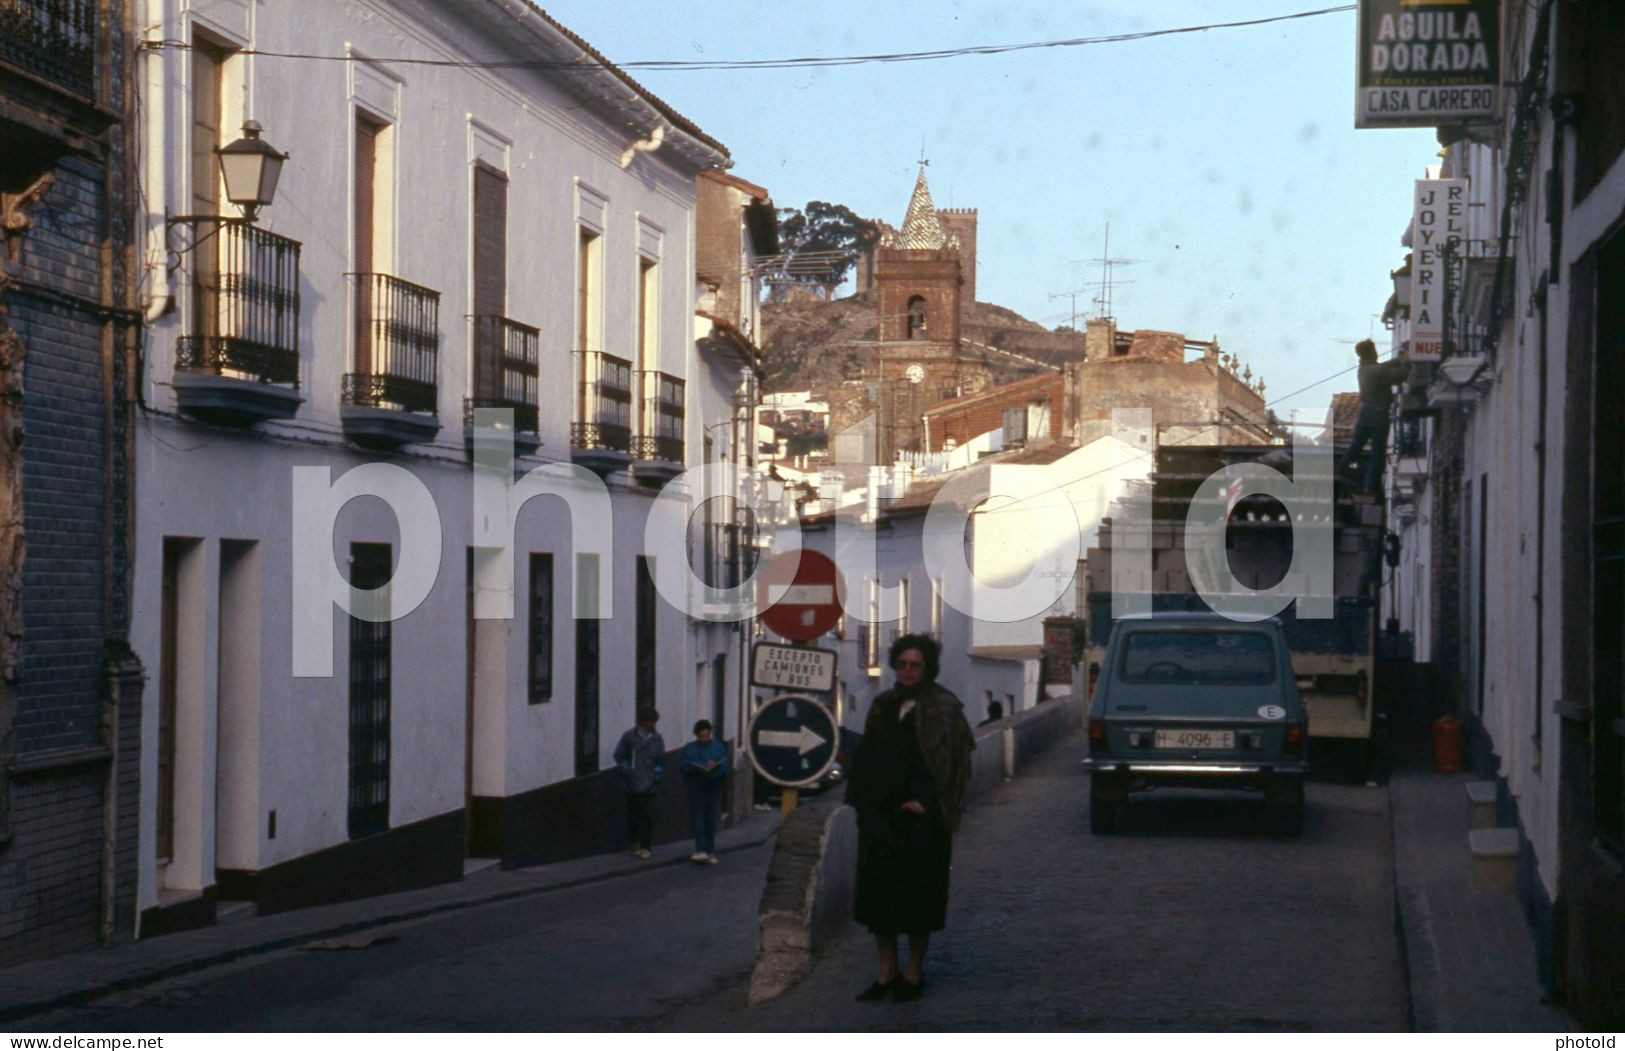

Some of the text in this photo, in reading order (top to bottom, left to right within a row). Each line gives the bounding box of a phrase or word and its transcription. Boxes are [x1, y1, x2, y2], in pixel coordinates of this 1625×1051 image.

[1378, 12, 1482, 41] AGUILA
[1372, 42, 1489, 72] DORADA
[1368, 88, 1493, 112] CASA CARRERO
[1418, 190, 1436, 324] JOYERIA
[769, 649, 820, 664] EXCEPTO
[764, 660, 823, 676] CAMIONES
[776, 673, 810, 686] Y BUS
[1267, 707, 1277, 717] E
